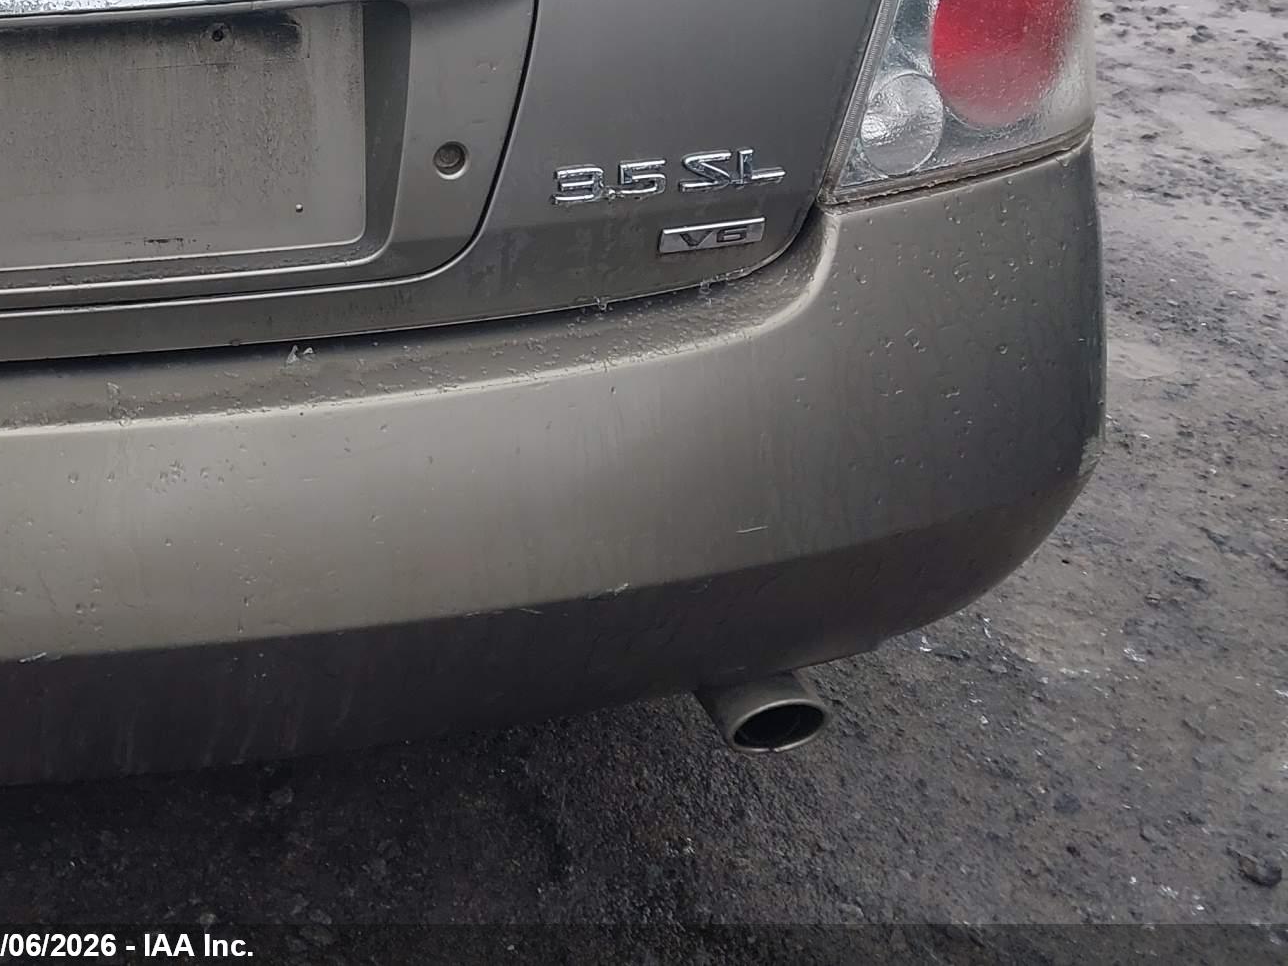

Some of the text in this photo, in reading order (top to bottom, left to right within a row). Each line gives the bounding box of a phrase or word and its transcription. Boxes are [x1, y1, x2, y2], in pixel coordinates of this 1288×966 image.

[552, 147, 786, 205] 3.5 SL
[679, 226, 749, 247] V6
